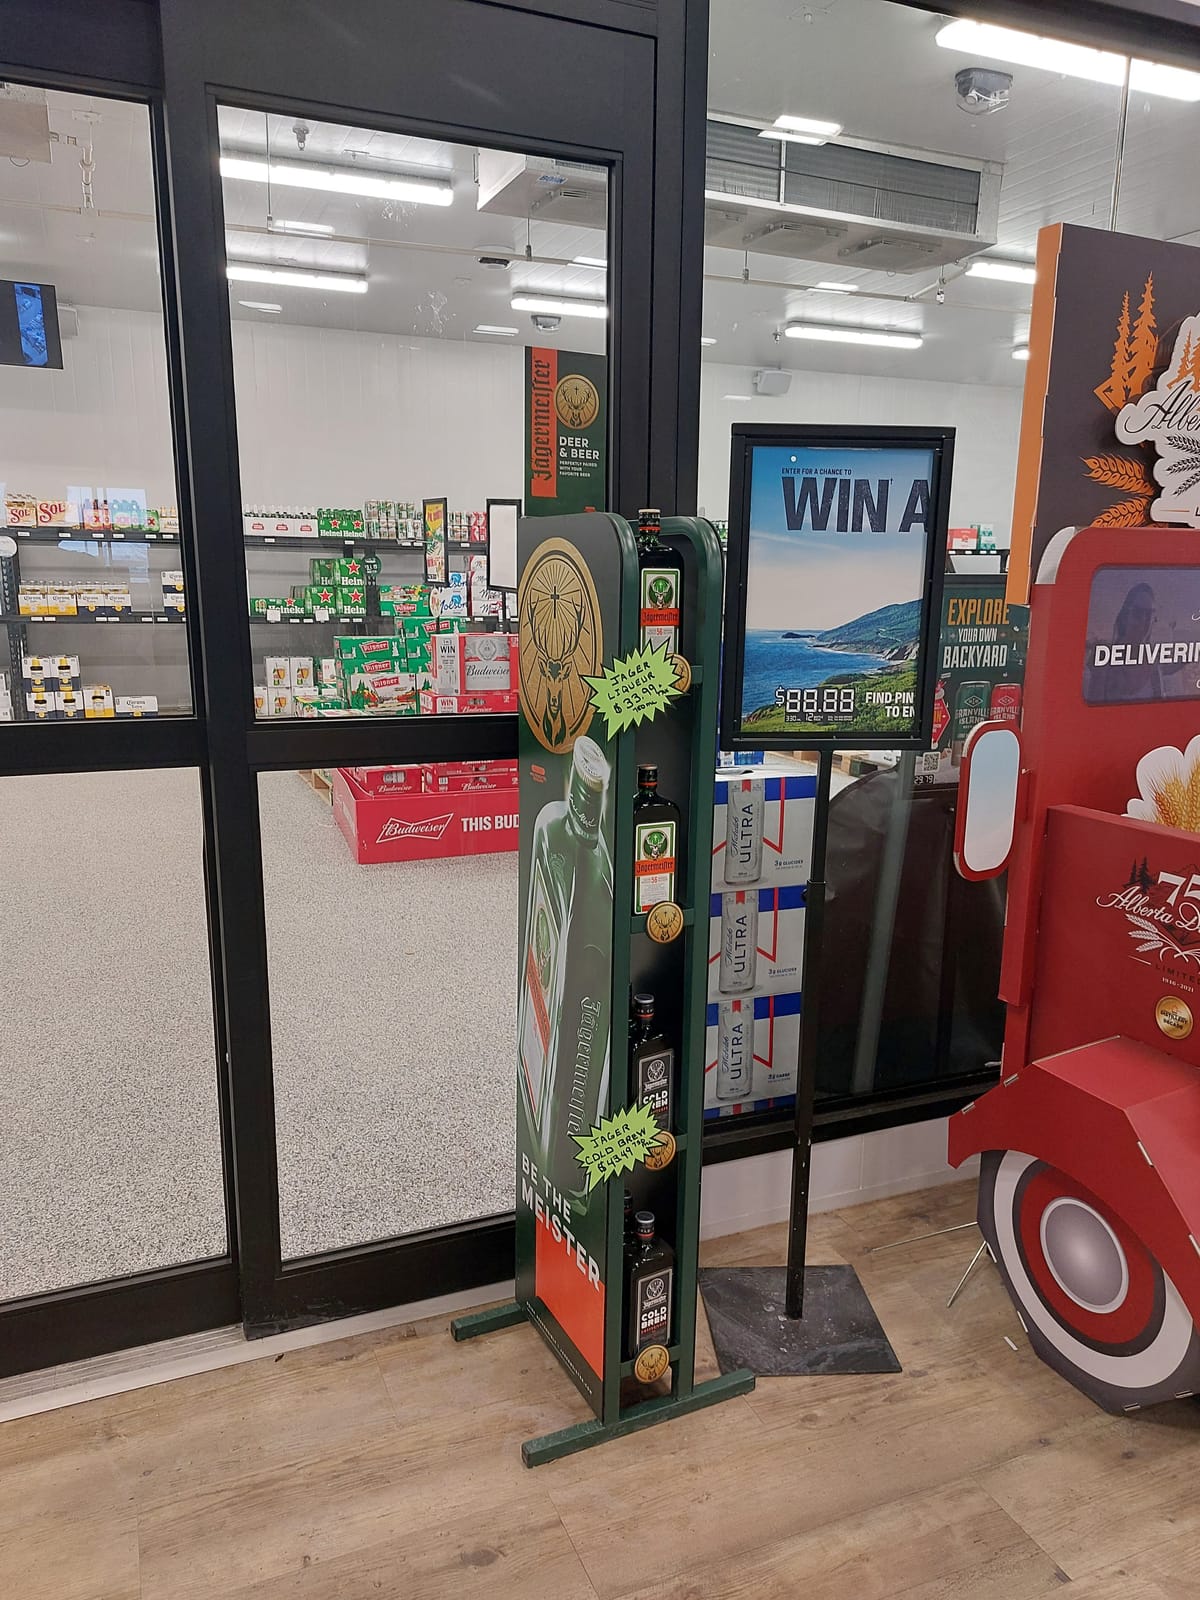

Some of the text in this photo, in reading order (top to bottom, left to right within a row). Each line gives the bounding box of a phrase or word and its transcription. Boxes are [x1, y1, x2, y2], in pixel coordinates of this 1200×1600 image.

[559, 436, 589, 448] DEER
[559, 447, 600, 460] & BEER
[782, 467, 800, 475] ENTER
[819, 468, 843, 476] CHANCE
[898, 479, 930, 533] A
[947, 598, 1010, 626] EXPLORE
[958, 627, 998, 643] YOUR OWN
[440, 645, 456, 654] WIN
[942, 644, 1008, 669] BACKYARD
[467, 664, 510, 677] Budweiser
[610, 661, 650, 687] JAGER
[607, 671, 655, 701] LIQUEUR
[865, 691, 914, 704] FIND PIN
[775, 686, 855, 713] $88.88
[884, 705, 900, 718] TO
[382, 822, 446, 837] Budweiser
[461, 814, 519, 832] THIS BUD
[739, 804, 753, 864] ULTRA
[1096, 886, 1174, 925] Alberta
[734, 915, 747, 973] ULTRA
[730, 1022, 743, 1080] ULTRA
[585, 1127, 646, 1166] COLD BREW
[590, 1123, 630, 1149] JAGER
[522, 1152, 571, 1225] BE THE
[521, 1177, 599, 1292] MEISTER
[641, 1306, 667, 1322] COLD
